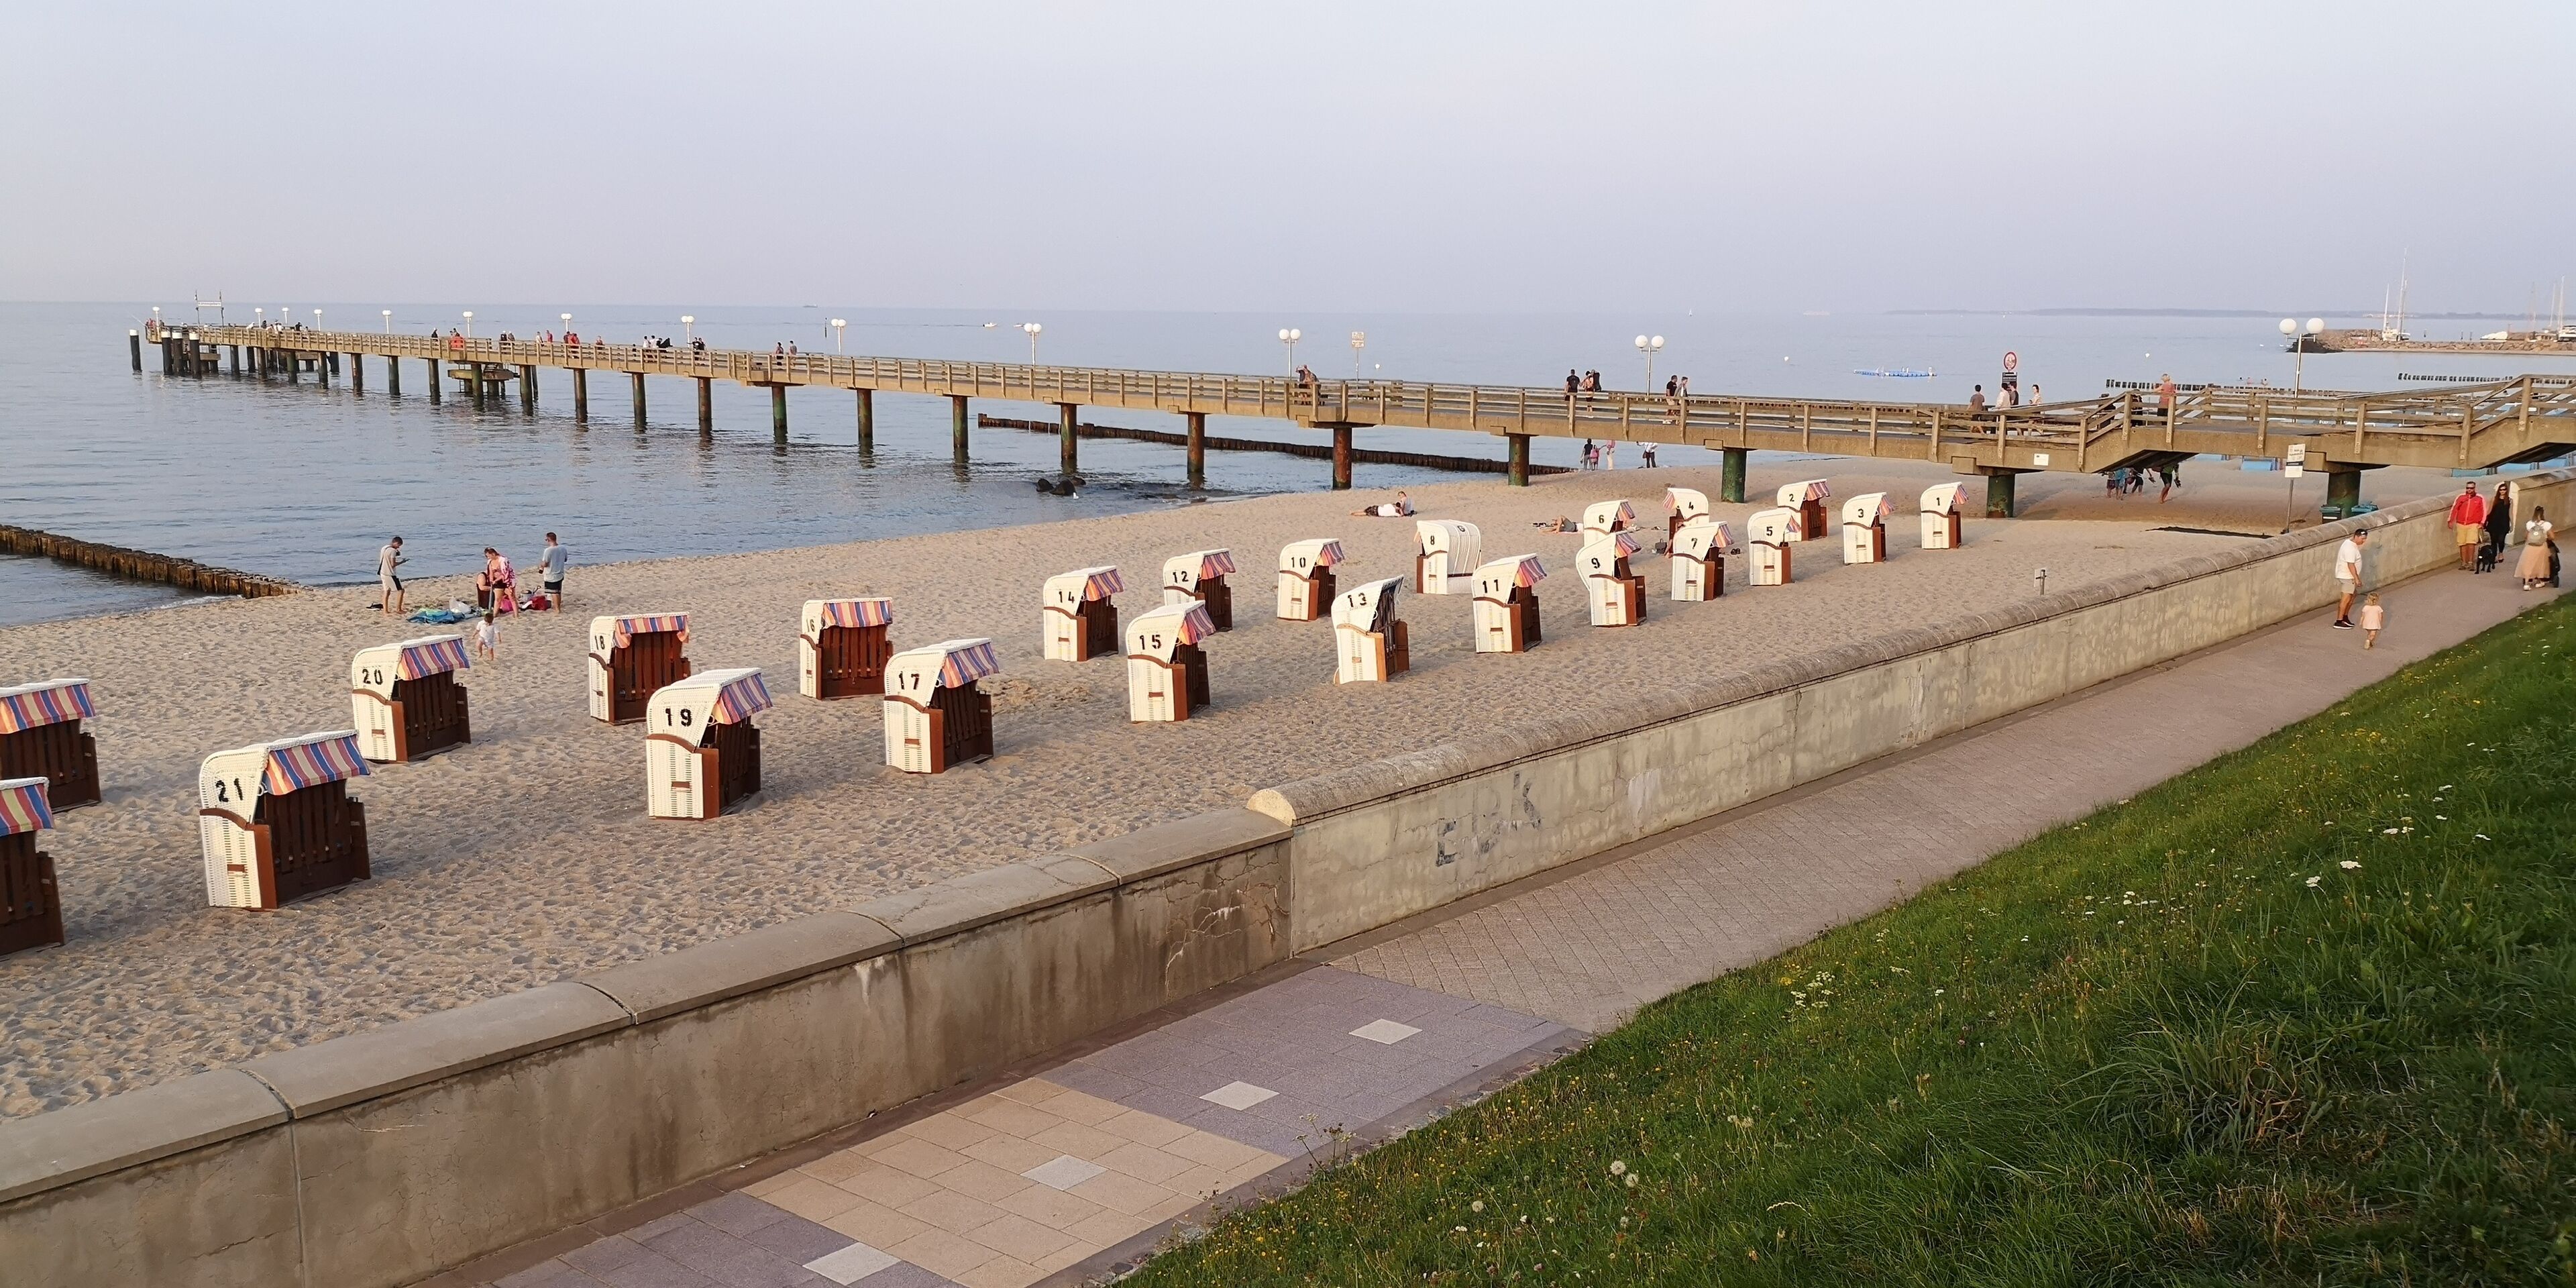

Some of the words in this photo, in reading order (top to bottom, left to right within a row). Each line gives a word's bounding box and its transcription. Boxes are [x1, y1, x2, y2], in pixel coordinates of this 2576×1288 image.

[1788, 493, 1795, 502] 2
[1936, 497, 1941, 506] 1
[1688, 501, 1695, 511] 4
[1599, 515, 1605, 524] 6
[1858, 508, 1864, 518] 3
[1766, 526, 1773, 537] 5
[1430, 535, 1435, 545] 8
[1691, 537, 1698, 549] 7
[1291, 557, 1306, 568] 10
[1591, 557, 1601, 570] 9
[1173, 570, 1189, 584] 12
[1482, 579, 1499, 594] 11
[1059, 591, 1075, 604] 14
[1347, 592, 1367, 608] 13
[806, 618, 815, 633] 16
[594, 635, 605, 650] 18
[1139, 634, 1162, 650] 15
[362, 668, 383, 685] 20
[898, 671, 920, 690] 17
[665, 708, 693, 727] 19
[215, 777, 244, 803] 21
